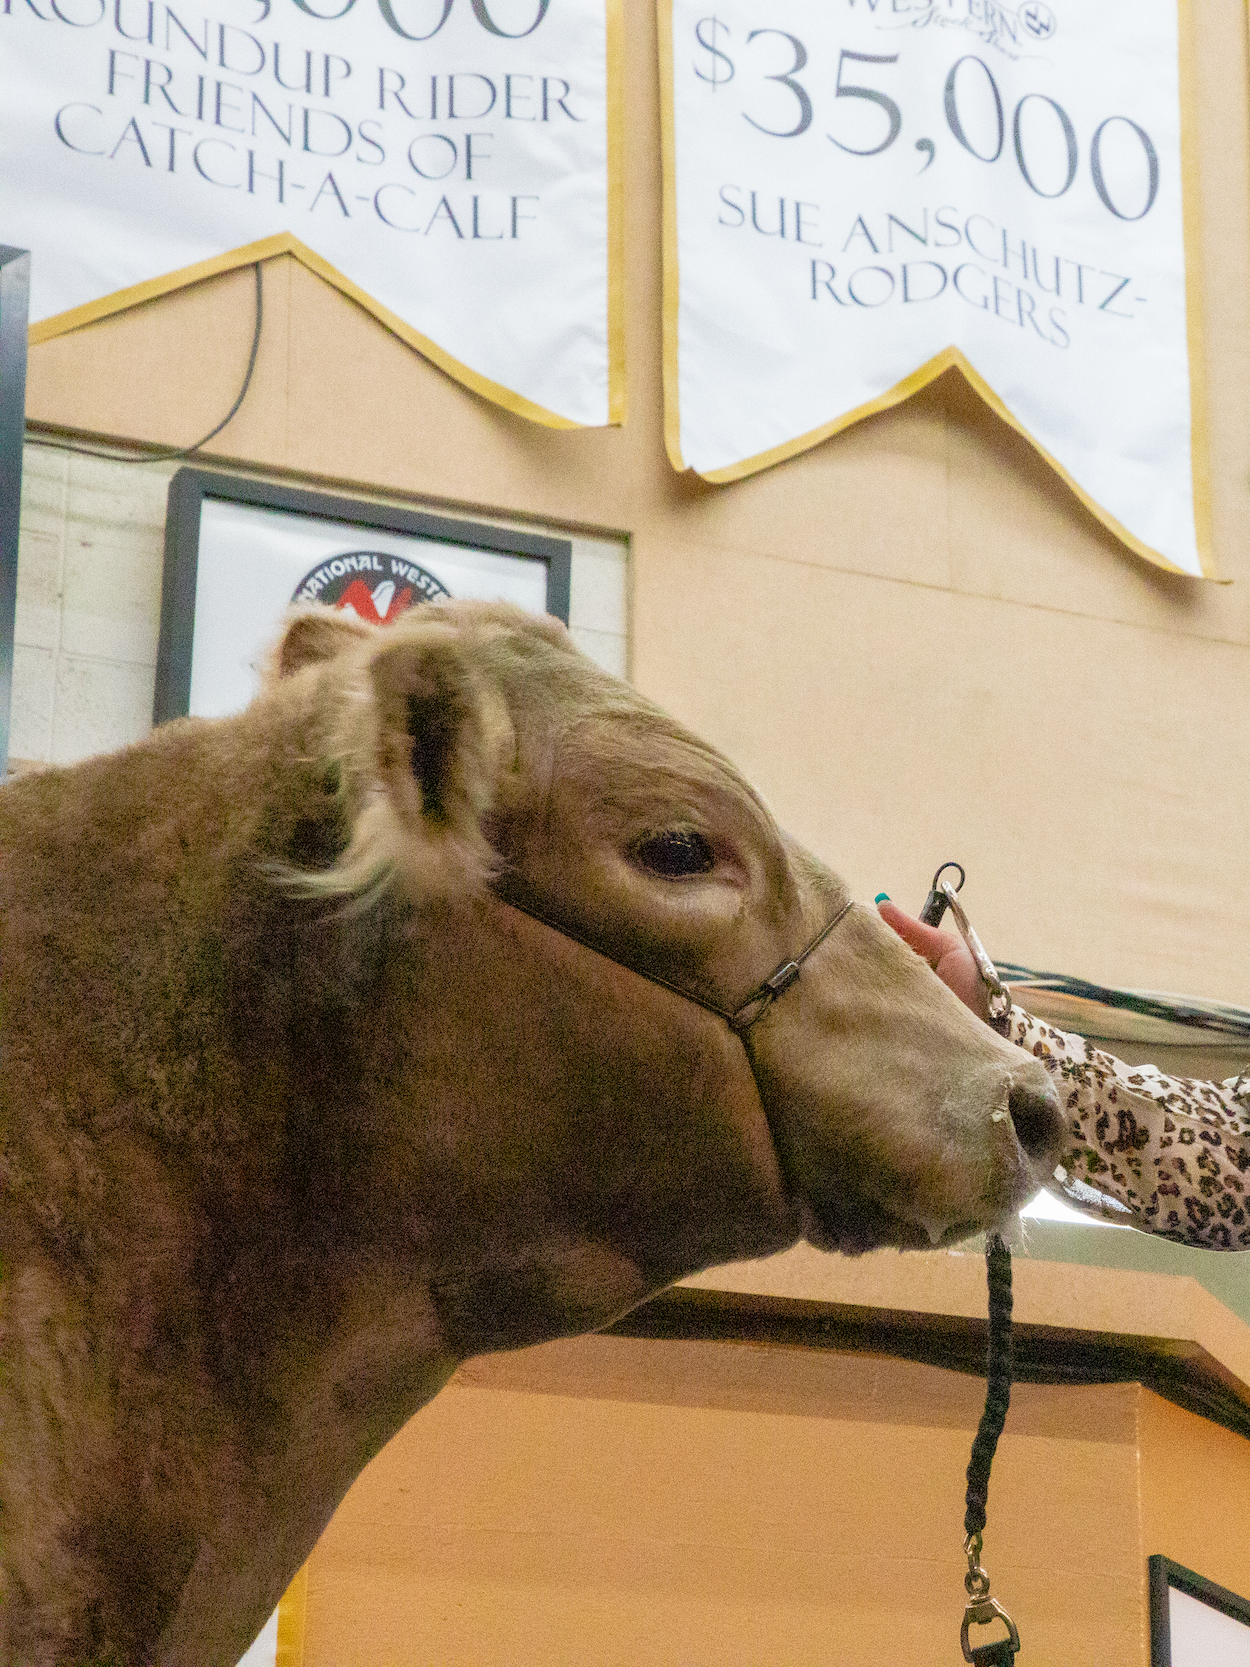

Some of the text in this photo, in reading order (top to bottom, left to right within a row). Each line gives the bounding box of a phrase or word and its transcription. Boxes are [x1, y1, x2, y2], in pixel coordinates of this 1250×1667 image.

[107, 48, 495, 181] FRIENDS OF
[377, 67, 588, 123] RIDER
[692, 14, 1160, 221] $35,000
[53, 101, 541, 240] CATCH-A-CALF
[716, 184, 1147, 319] SUE ANSCHUTZ-
[809, 258, 1070, 350] RODGERS
[297, 554, 384, 602] NATIONAL
